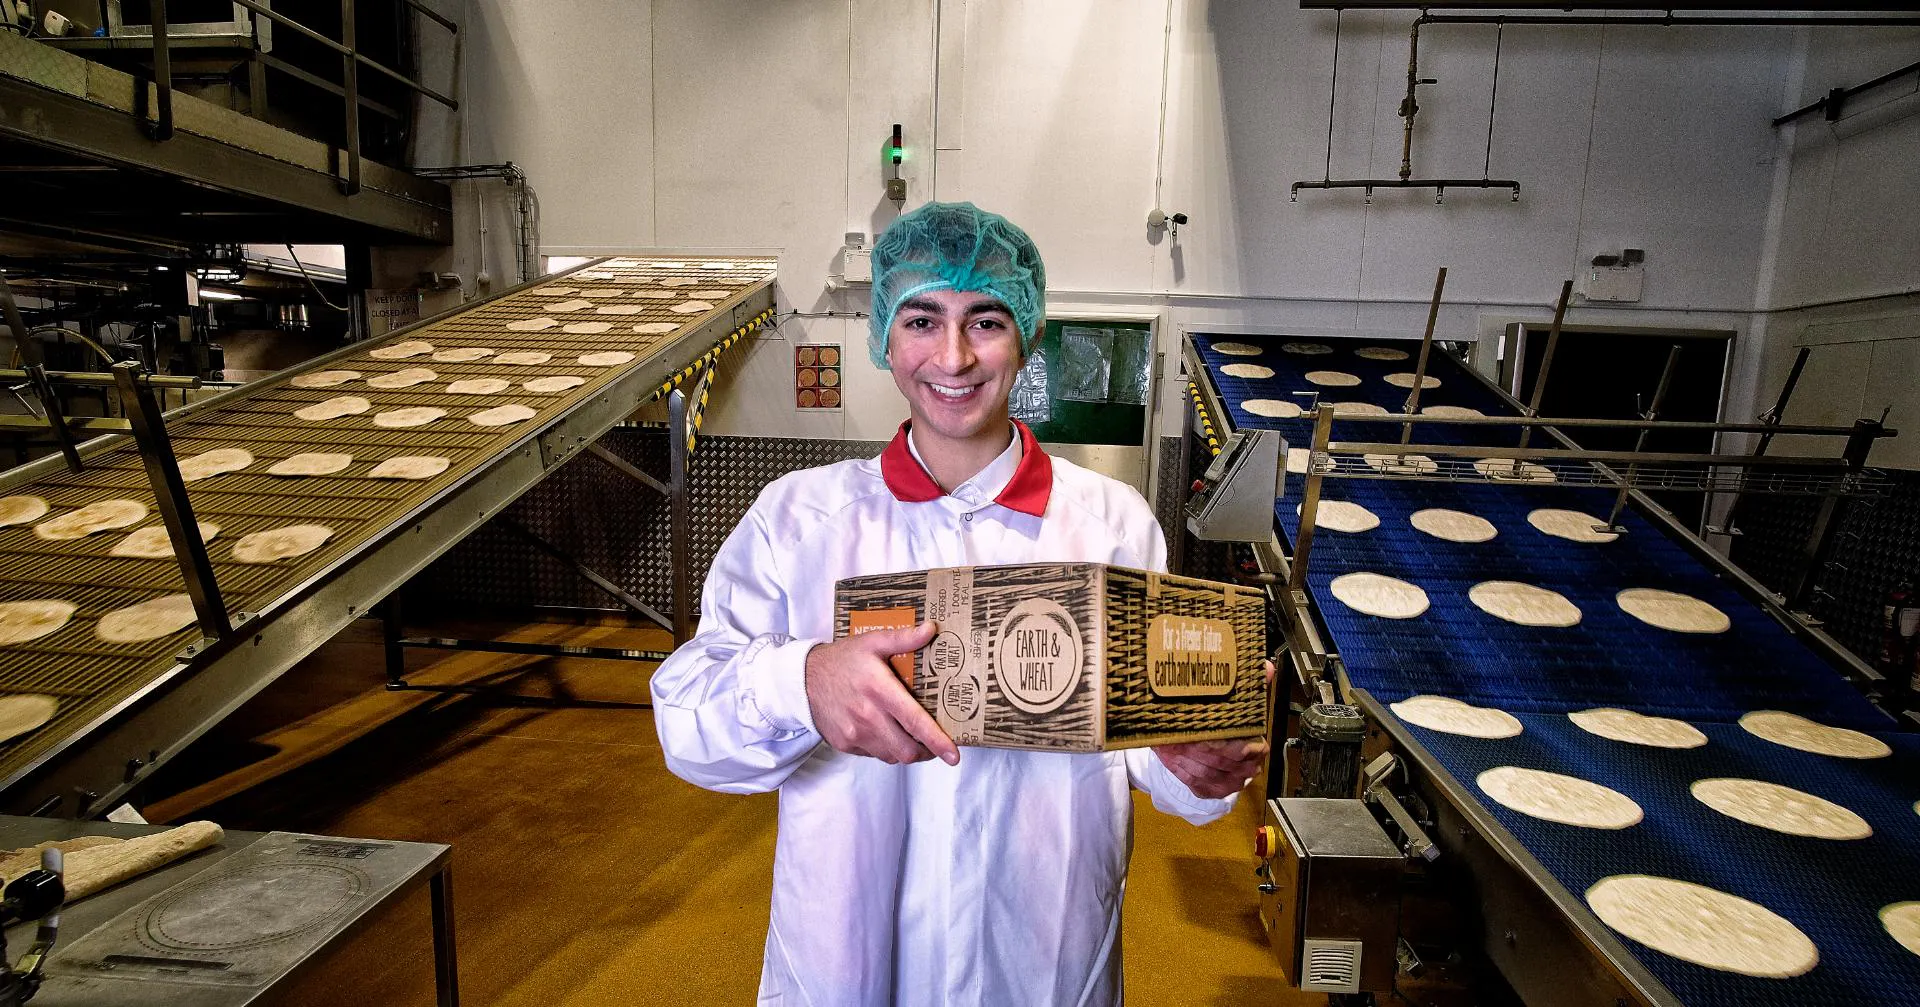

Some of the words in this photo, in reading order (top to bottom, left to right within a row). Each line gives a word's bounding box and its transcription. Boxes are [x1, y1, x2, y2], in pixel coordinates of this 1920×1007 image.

[371, 309, 400, 318] CLOSED
[938, 588, 947, 622] ORDERED
[961, 583, 970, 606] MEAL
[929, 602, 938, 620] BOX
[936, 640, 947, 648] &
[973, 629, 982, 659] RESHER
[1016, 629, 1048, 658] EARTH
[1050, 632, 1061, 658] &
[1162, 619, 1174, 651] for
[1175, 629, 1181, 651] a
[935, 648, 947, 670] EARTH
[947, 645, 960, 668] WHEAT
[1019, 662, 1055, 691] WHEAT
[1154, 651, 1230, 687] earthandwheat.com
[947, 684, 960, 707] WHEAT
[961, 683, 974, 705] EARTH
[960, 705, 971, 713] &
